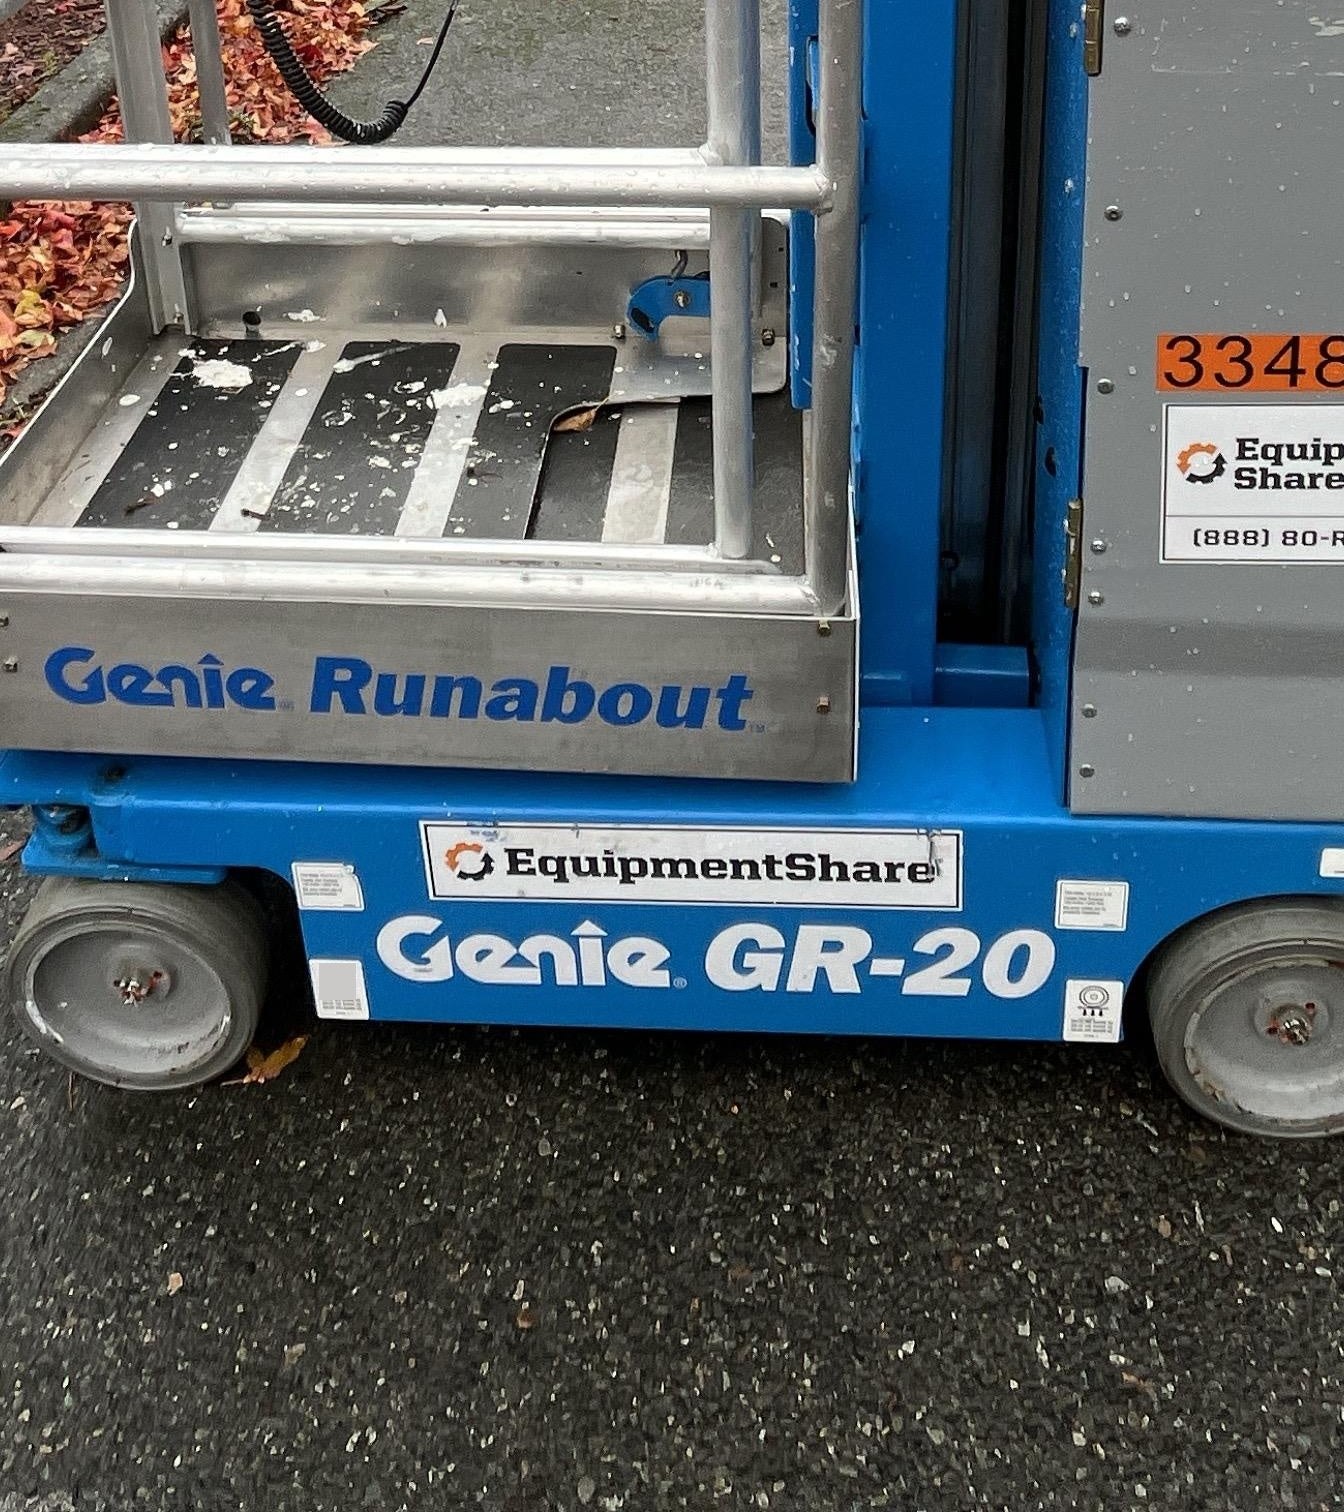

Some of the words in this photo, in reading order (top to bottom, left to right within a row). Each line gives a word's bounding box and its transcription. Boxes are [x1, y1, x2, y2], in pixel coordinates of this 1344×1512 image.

[1192, 528, 1270, 548] (888)
[43, 646, 277, 711] Genie
[309, 656, 756, 731] Runabout
[504, 847, 936, 886] EquipmentShare
[375, 914, 672, 989] Genie
[703, 924, 1056, 999] GR-20
